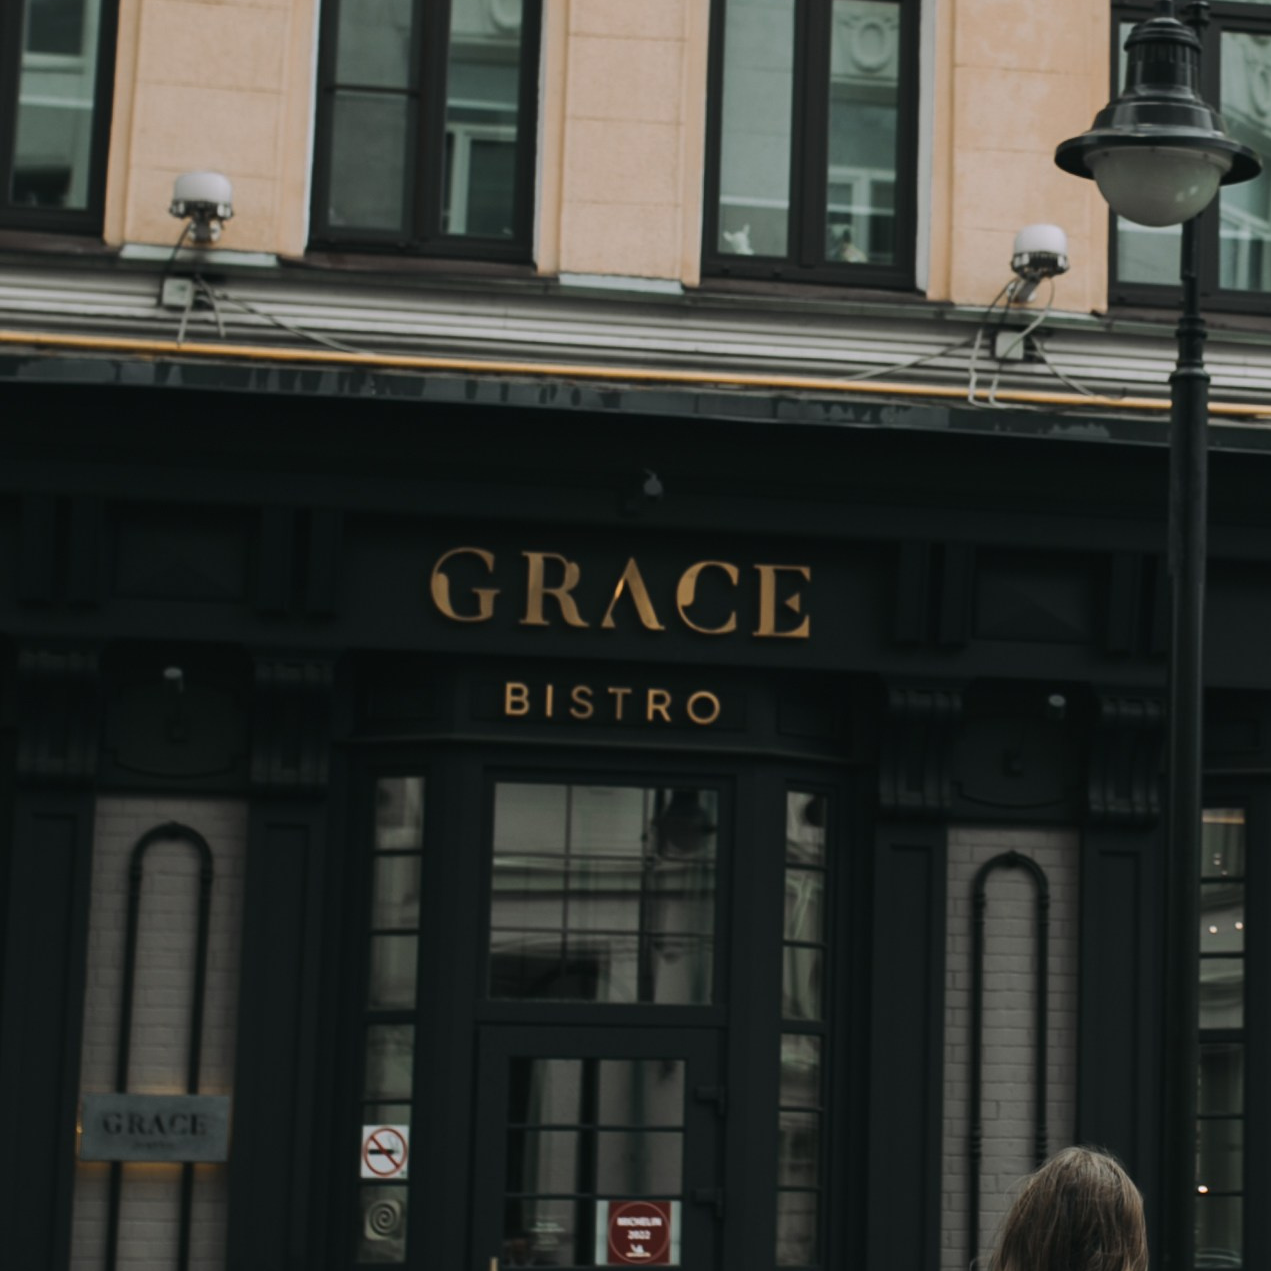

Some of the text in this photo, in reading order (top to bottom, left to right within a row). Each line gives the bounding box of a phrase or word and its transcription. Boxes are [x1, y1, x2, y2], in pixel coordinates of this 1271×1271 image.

[430, 547, 811, 638] GRACE
[505, 682, 721, 724] BISTRO
[102, 1112, 207, 1136] GRACE
